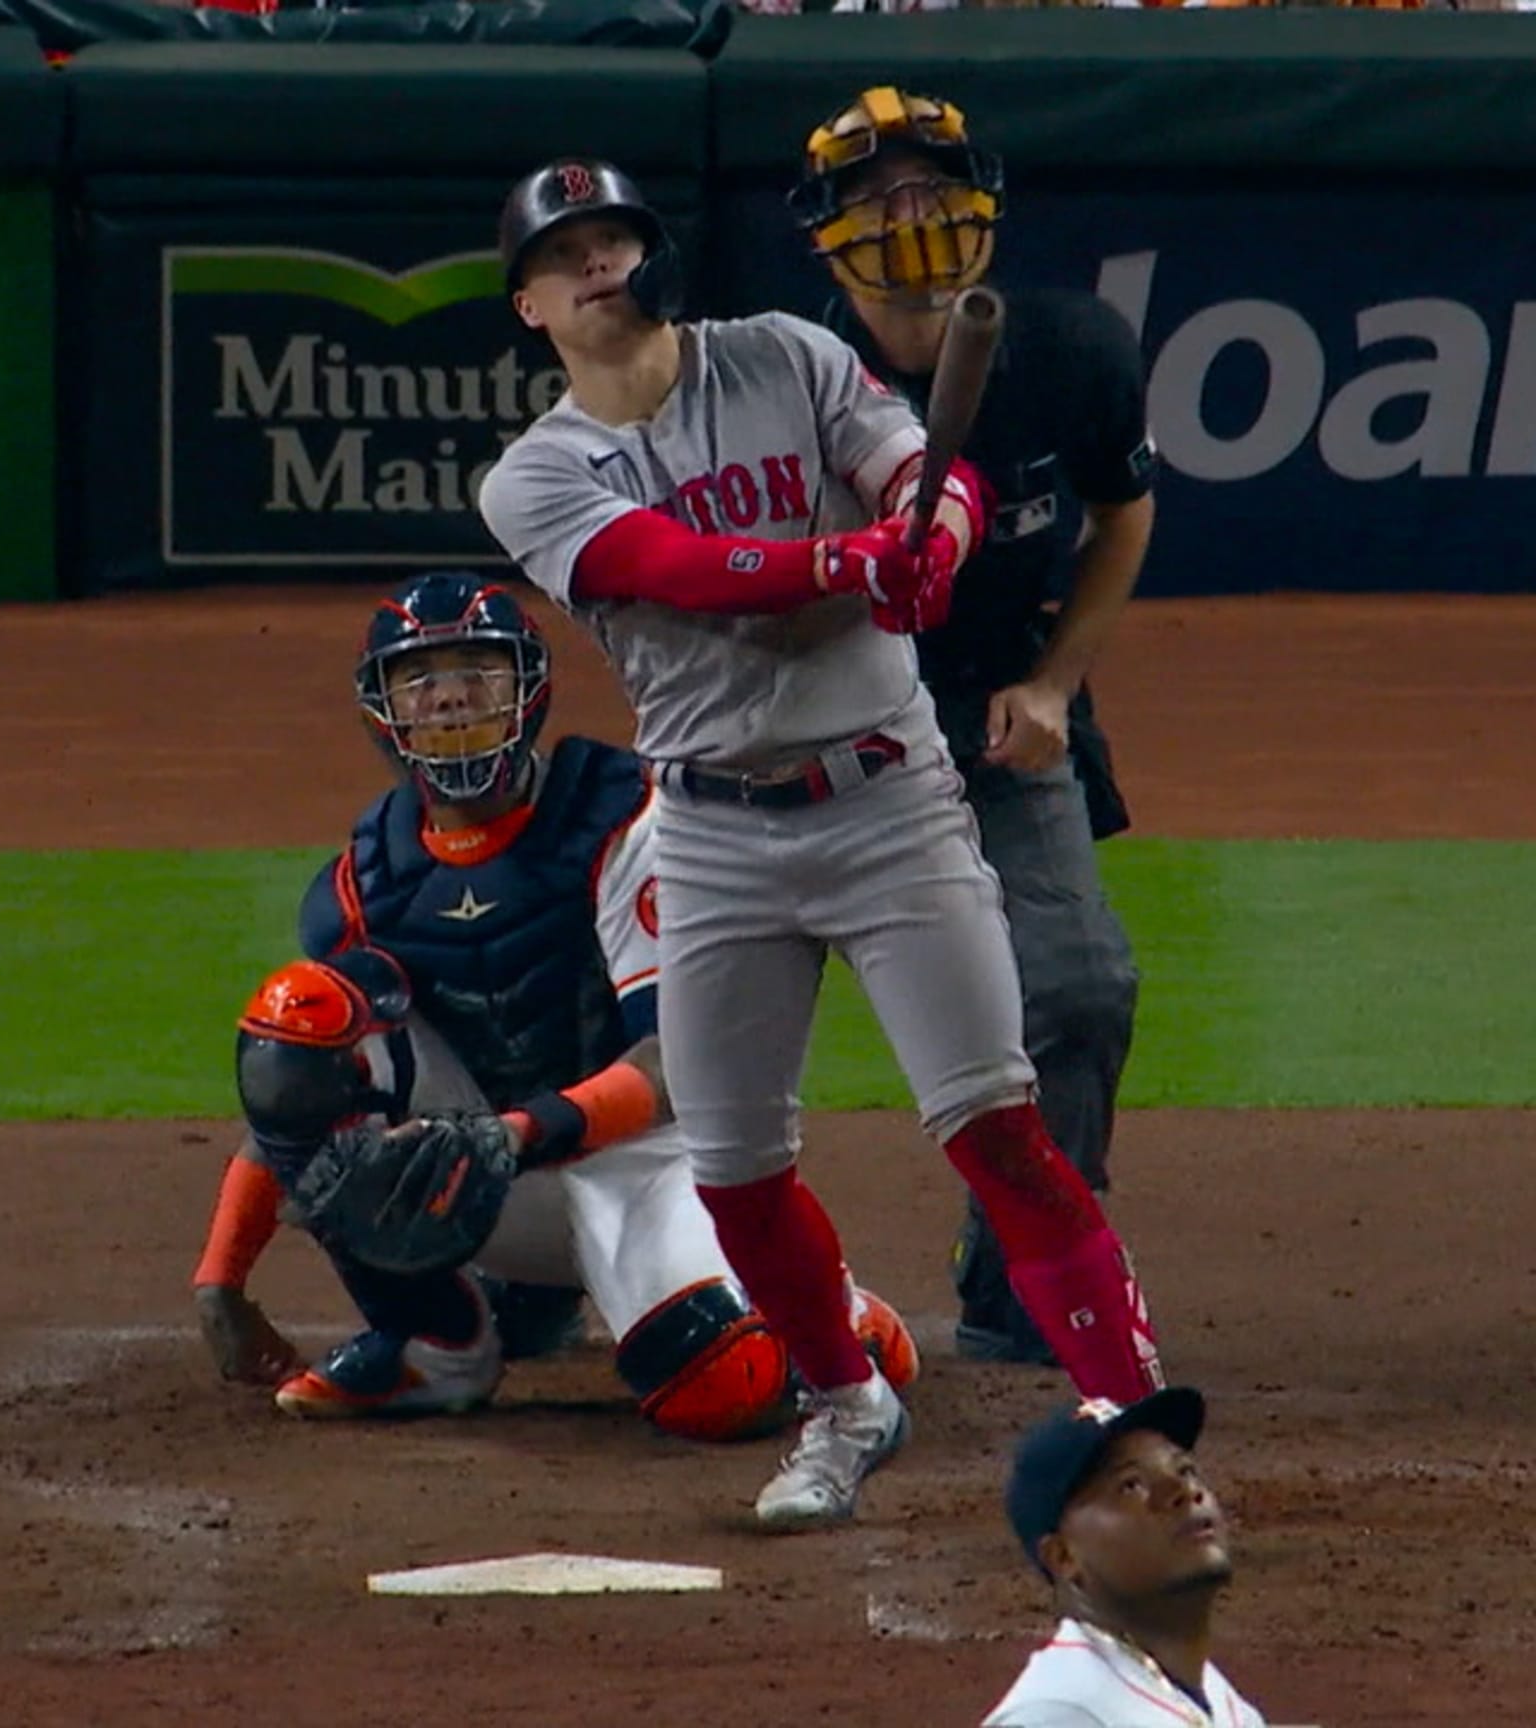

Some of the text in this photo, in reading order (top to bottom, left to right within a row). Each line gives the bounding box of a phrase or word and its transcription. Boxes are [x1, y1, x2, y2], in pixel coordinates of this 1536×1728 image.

[559, 164, 594, 202] B
[1096, 249, 1536, 482] oa
[264, 426, 519, 512] Mai
[651, 453, 811, 536] TON
[727, 547, 764, 573] 5
